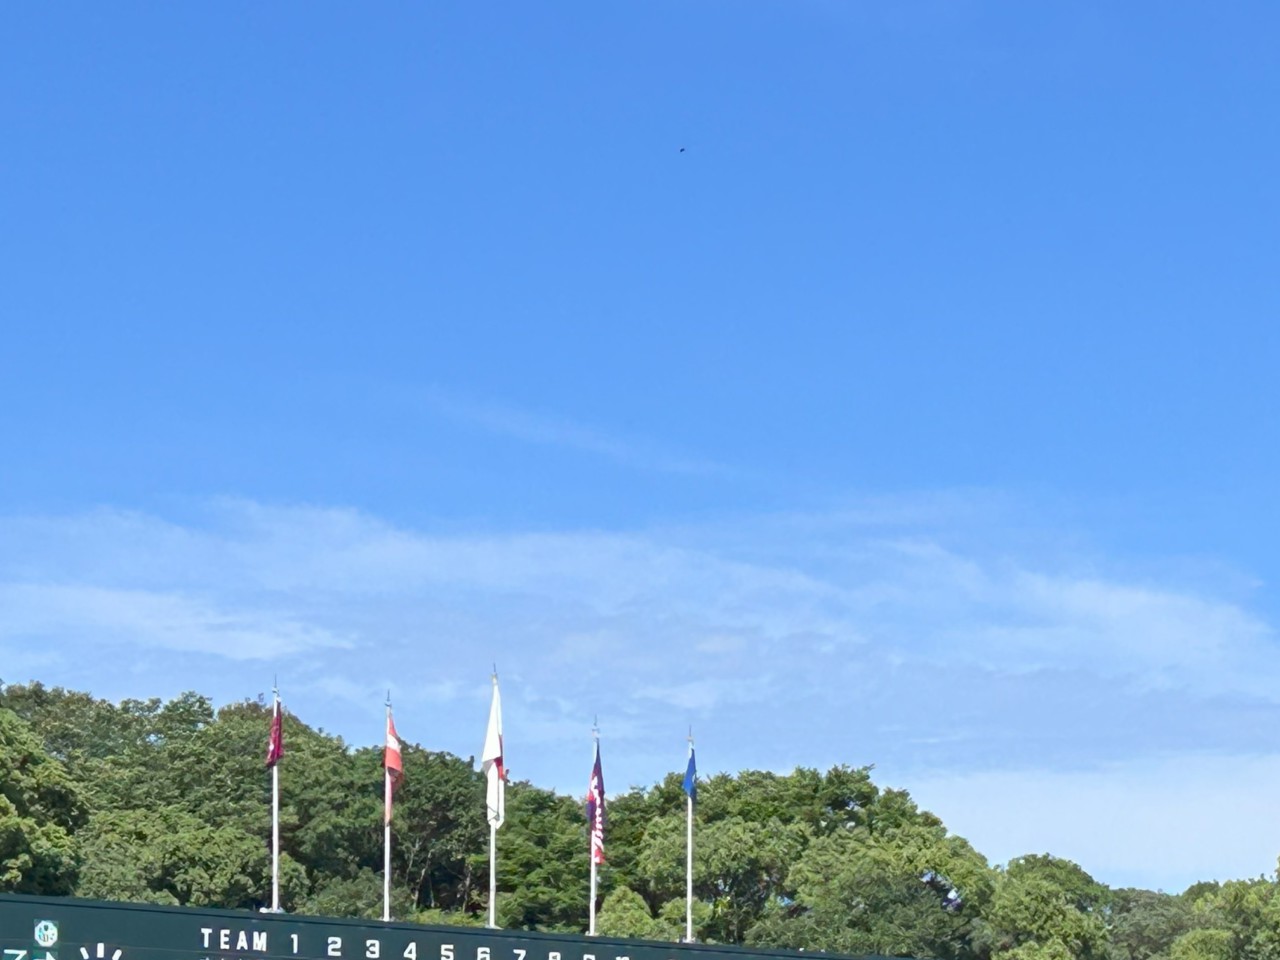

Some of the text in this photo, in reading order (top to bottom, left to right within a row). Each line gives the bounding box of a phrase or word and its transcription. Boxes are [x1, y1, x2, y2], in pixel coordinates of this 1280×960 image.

[200, 927, 267, 952] TEAM
[290, 933, 298, 954] 1
[327, 936, 342, 957] 2
[365, 939, 380, 959] 3
[403, 942, 417, 960] 4
